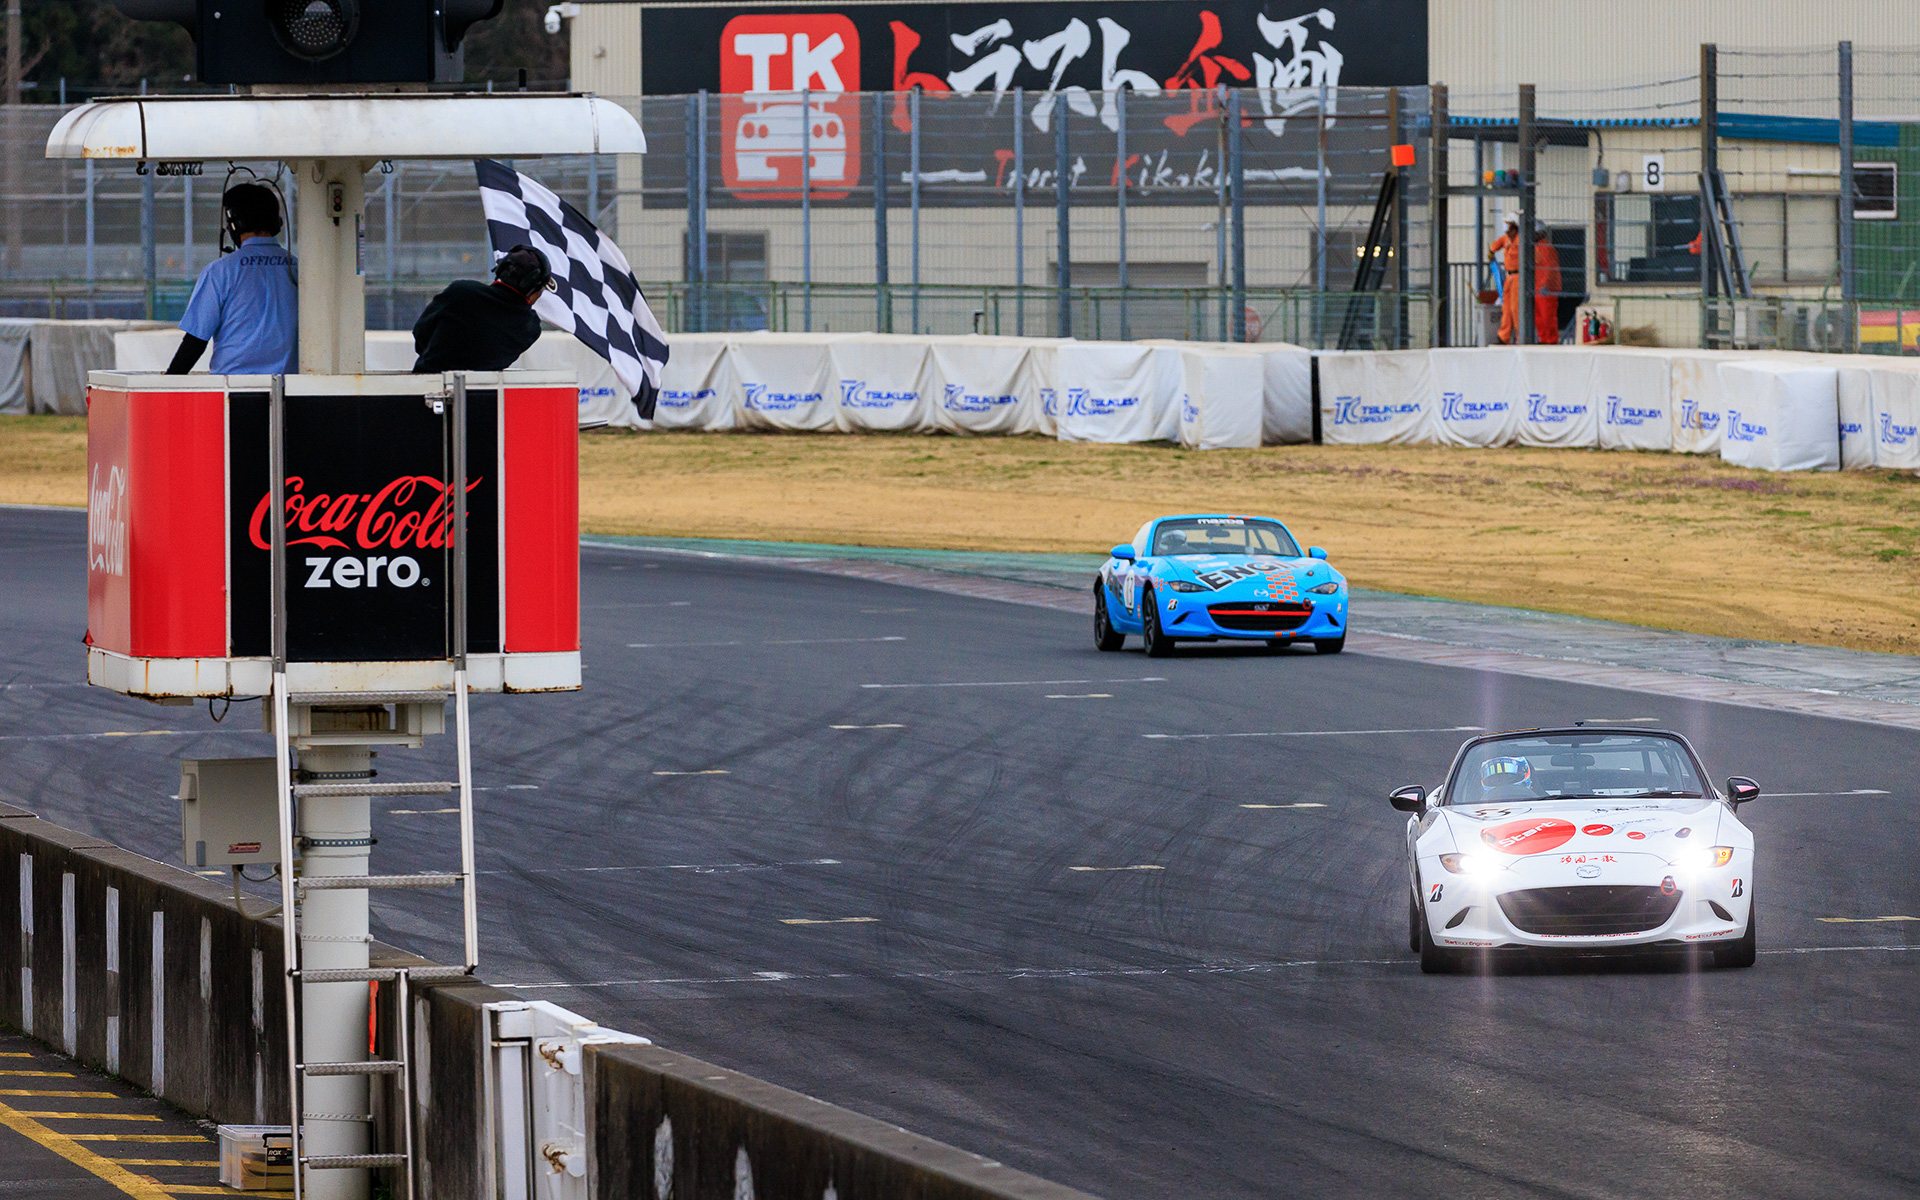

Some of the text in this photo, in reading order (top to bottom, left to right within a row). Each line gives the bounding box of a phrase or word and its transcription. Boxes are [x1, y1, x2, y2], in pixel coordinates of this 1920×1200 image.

[734, 32, 845, 92] TK
[888, 8, 1343, 137] トラスト企画
[1647, 162, 1659, 185] 8
[241, 255, 297, 267] OFFICIAL
[767, 392, 824, 402] TSUKUBA
[866, 390, 920, 401] TSUKUBA
[964, 394, 1019, 405] TSUKUBA
[1091, 397, 1140, 407] TSUKUBA
[1463, 401, 1510, 412] TSUKUBA
[1362, 403, 1421, 415] TSUKUBA
[1546, 404, 1588, 415] TSUKUBA
[1622, 407, 1663, 419] TSUKUBA
[1699, 410, 1720, 421] TSUK
[248, 475, 483, 550] Coca-Cola
[1498, 821, 1557, 848] Start
